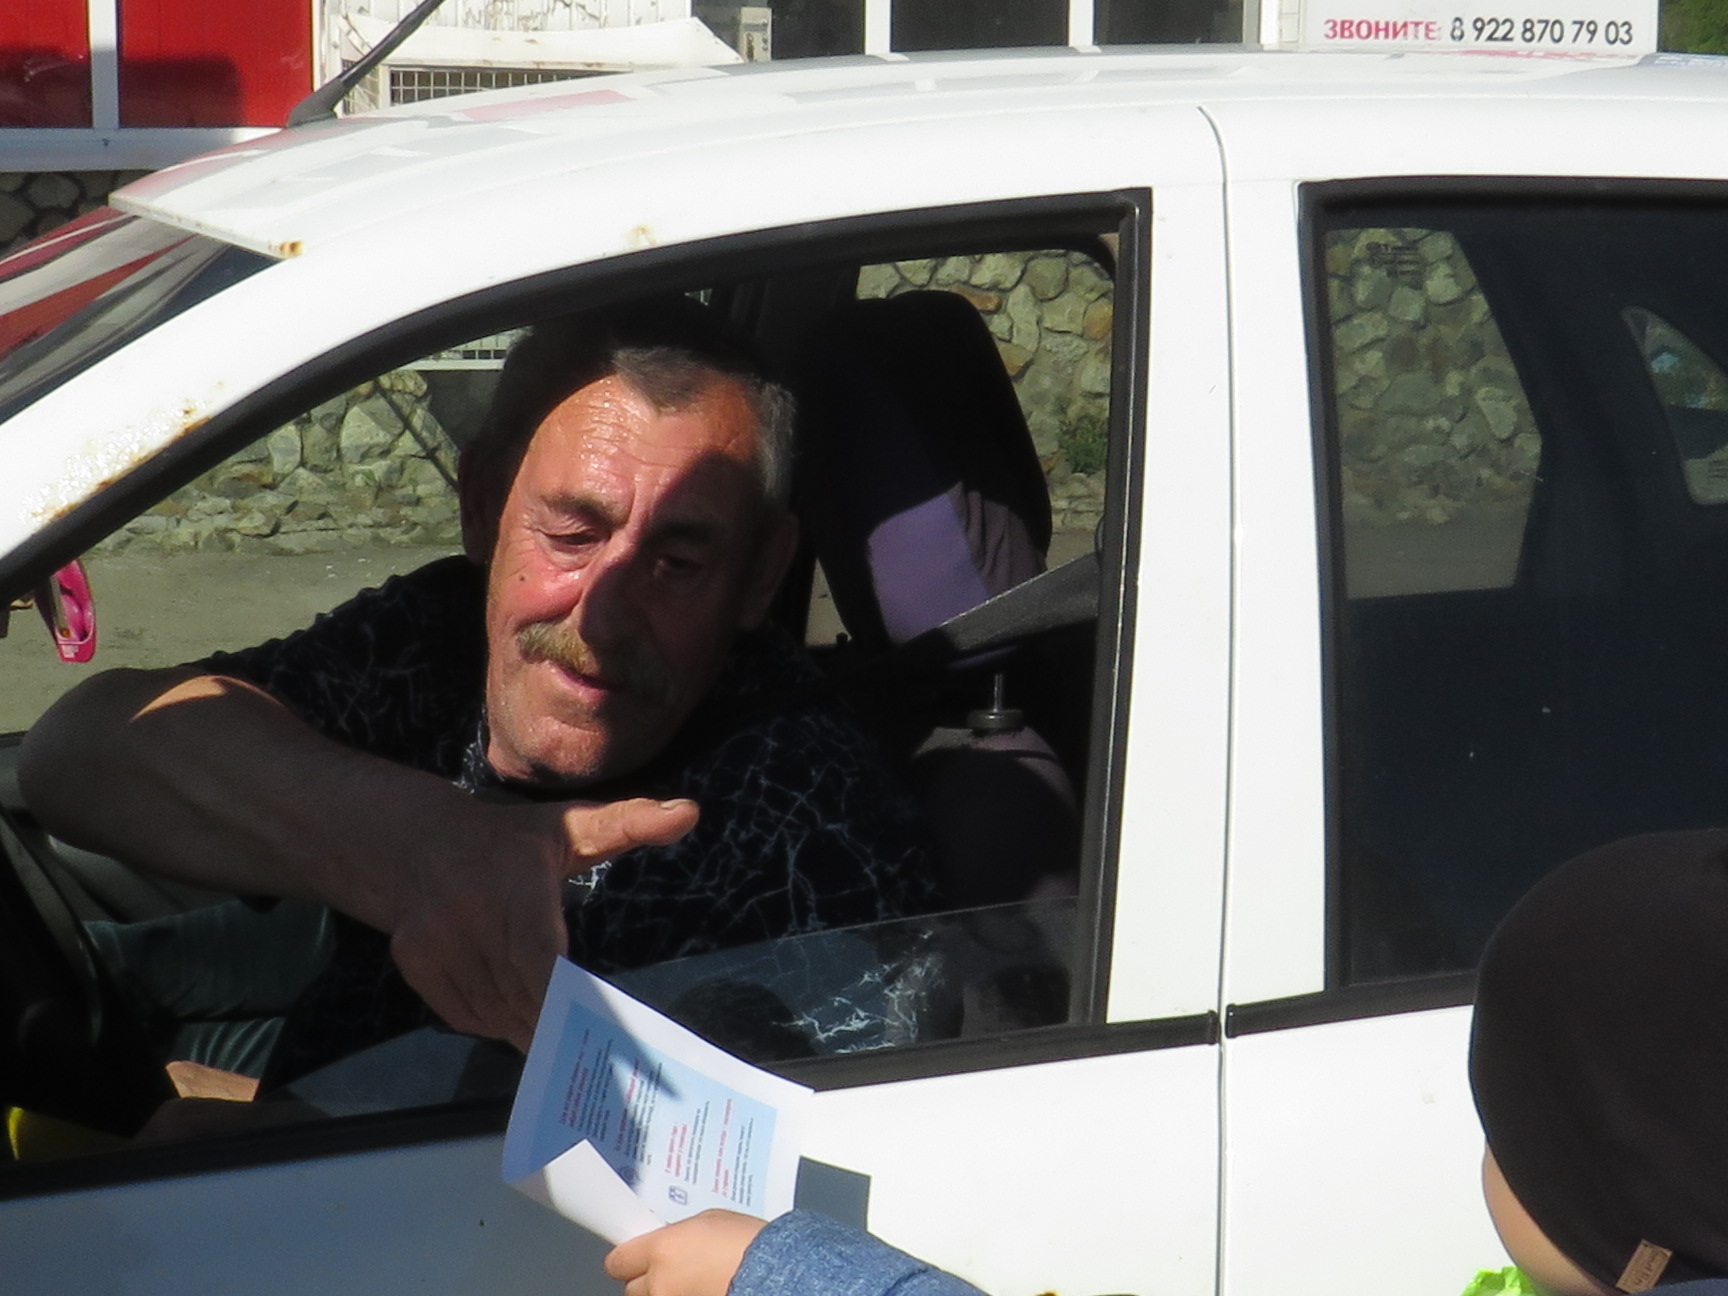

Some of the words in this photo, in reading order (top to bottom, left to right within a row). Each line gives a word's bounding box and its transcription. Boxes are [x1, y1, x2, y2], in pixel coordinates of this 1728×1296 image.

[1450, 17, 1466, 42] 8
[1472, 17, 1515, 43] 922
[1521, 18, 1565, 44] 870
[1571, 19, 1599, 45] 79
[1605, 20, 1633, 45] 03
